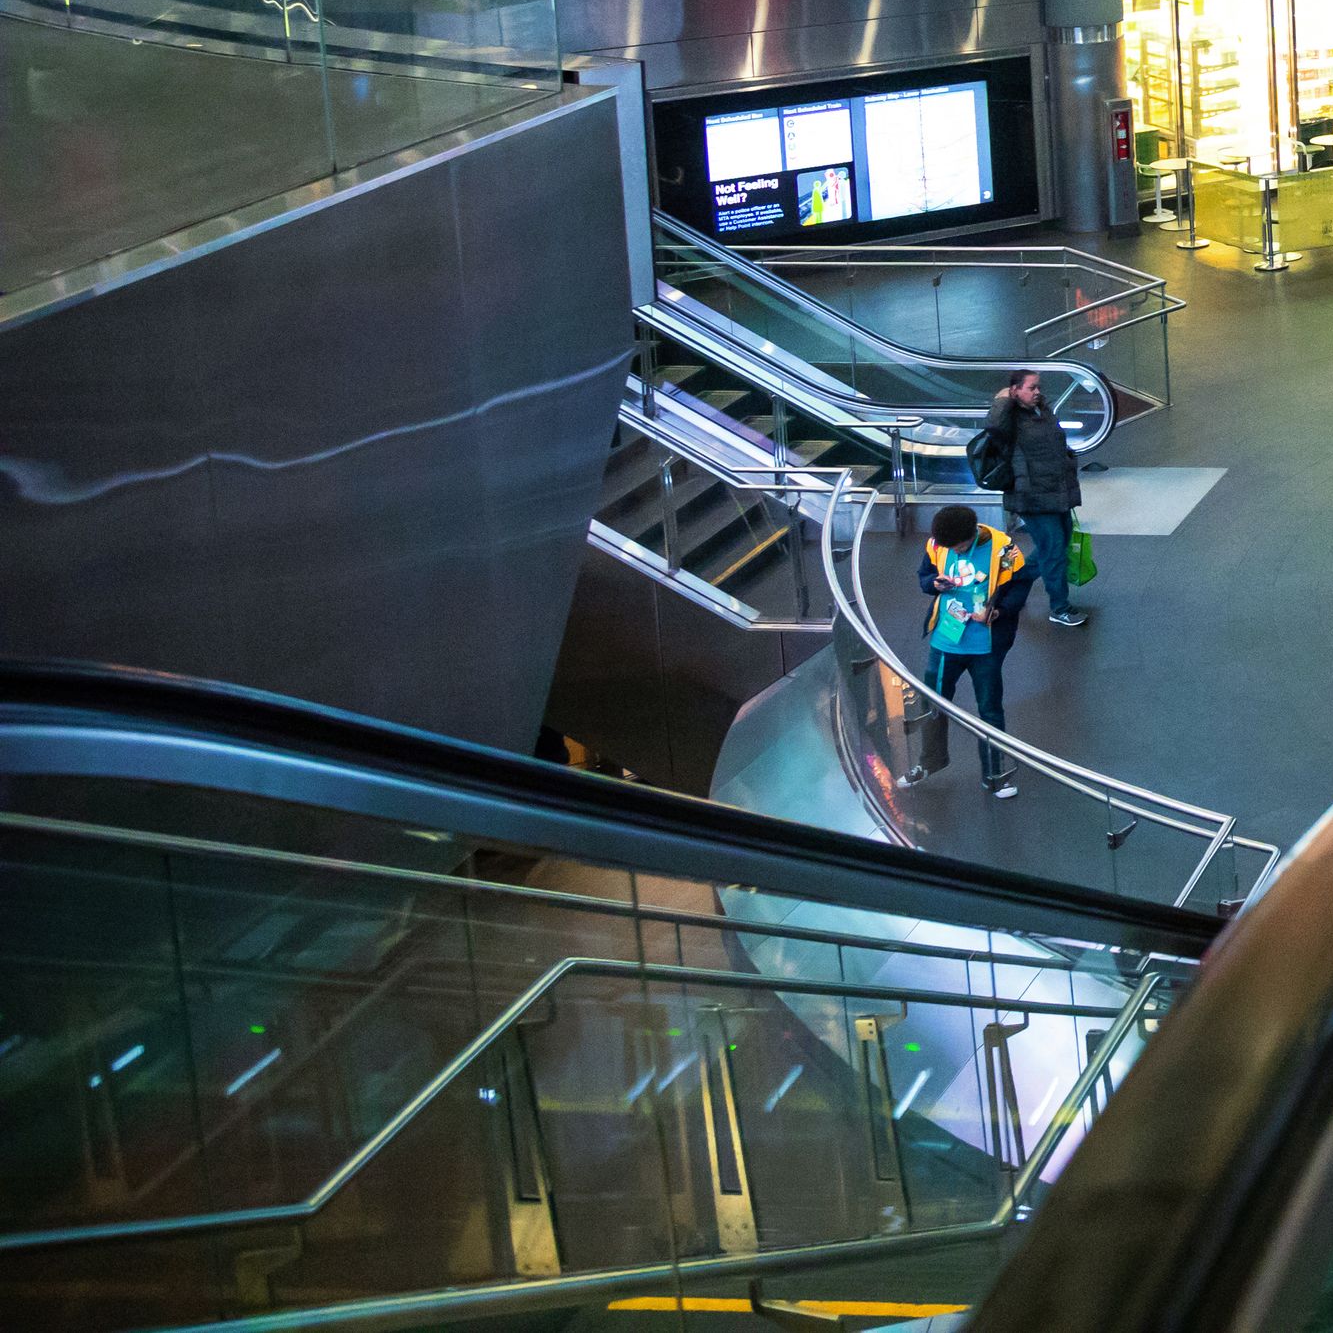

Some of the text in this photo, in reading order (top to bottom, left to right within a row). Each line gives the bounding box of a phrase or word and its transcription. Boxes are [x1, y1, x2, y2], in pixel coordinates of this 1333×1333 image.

[715, 178, 779, 195] Not Feeling
[715, 192, 748, 206] Well?
